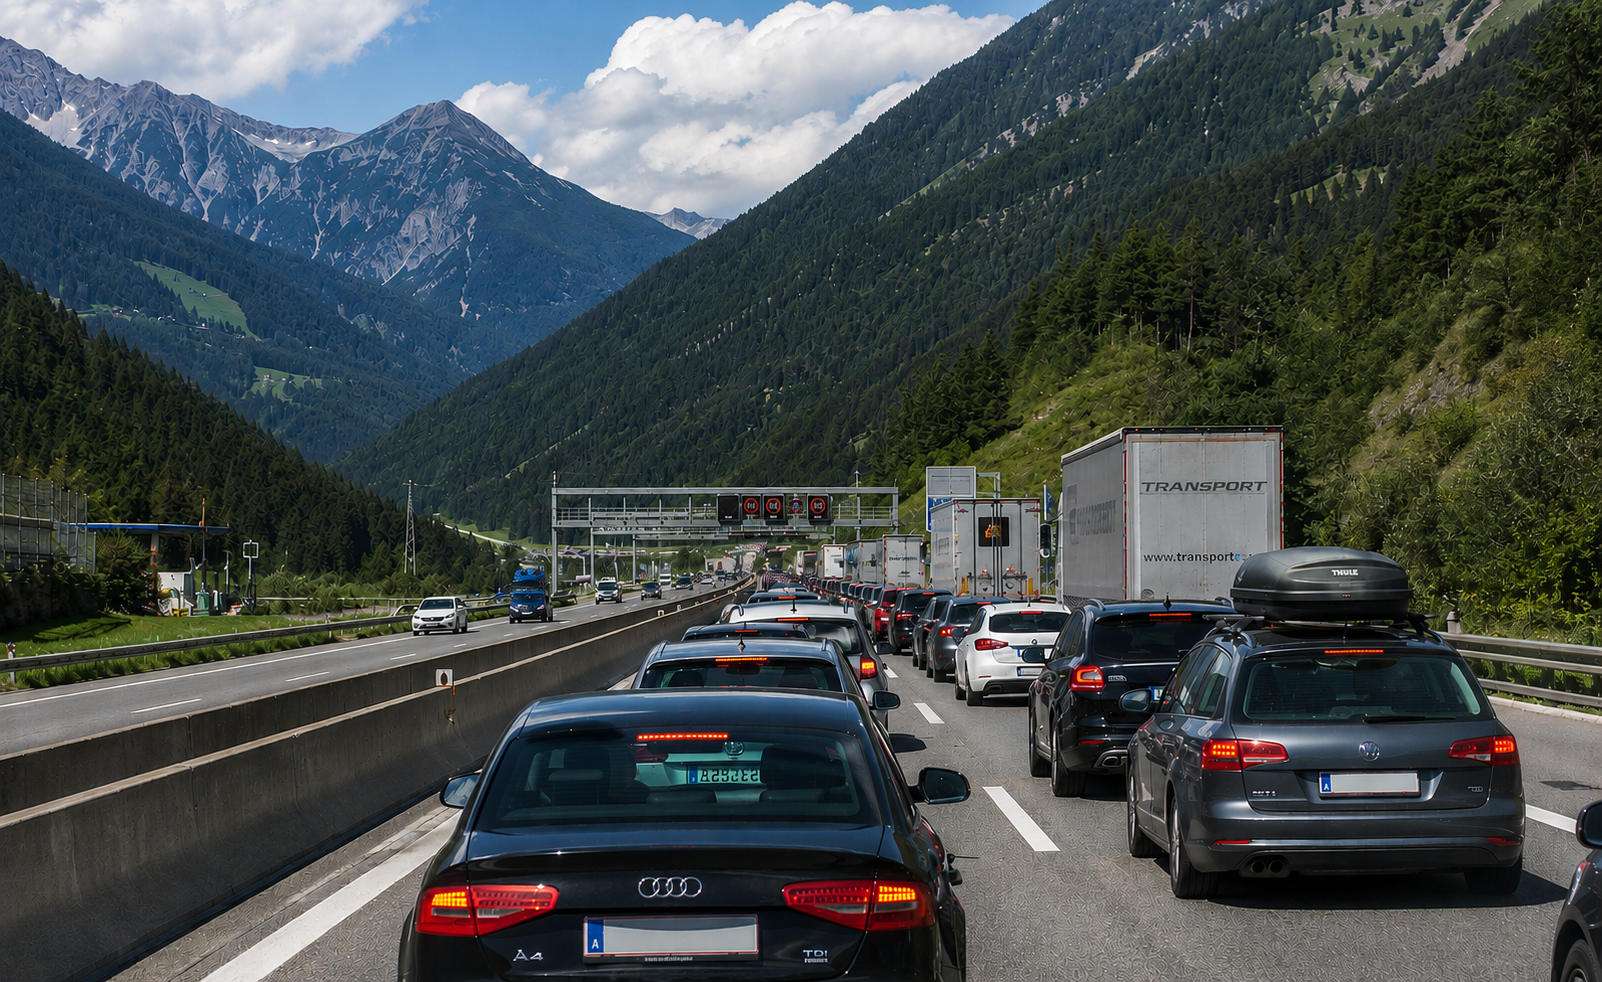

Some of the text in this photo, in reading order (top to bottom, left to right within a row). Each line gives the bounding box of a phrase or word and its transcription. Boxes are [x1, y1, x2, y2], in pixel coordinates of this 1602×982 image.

[1141, 481, 1268, 492] TRANSPORT
[591, 938, 600, 950] A
[512, 949, 544, 961] A4
[803, 949, 828, 958] TDI
